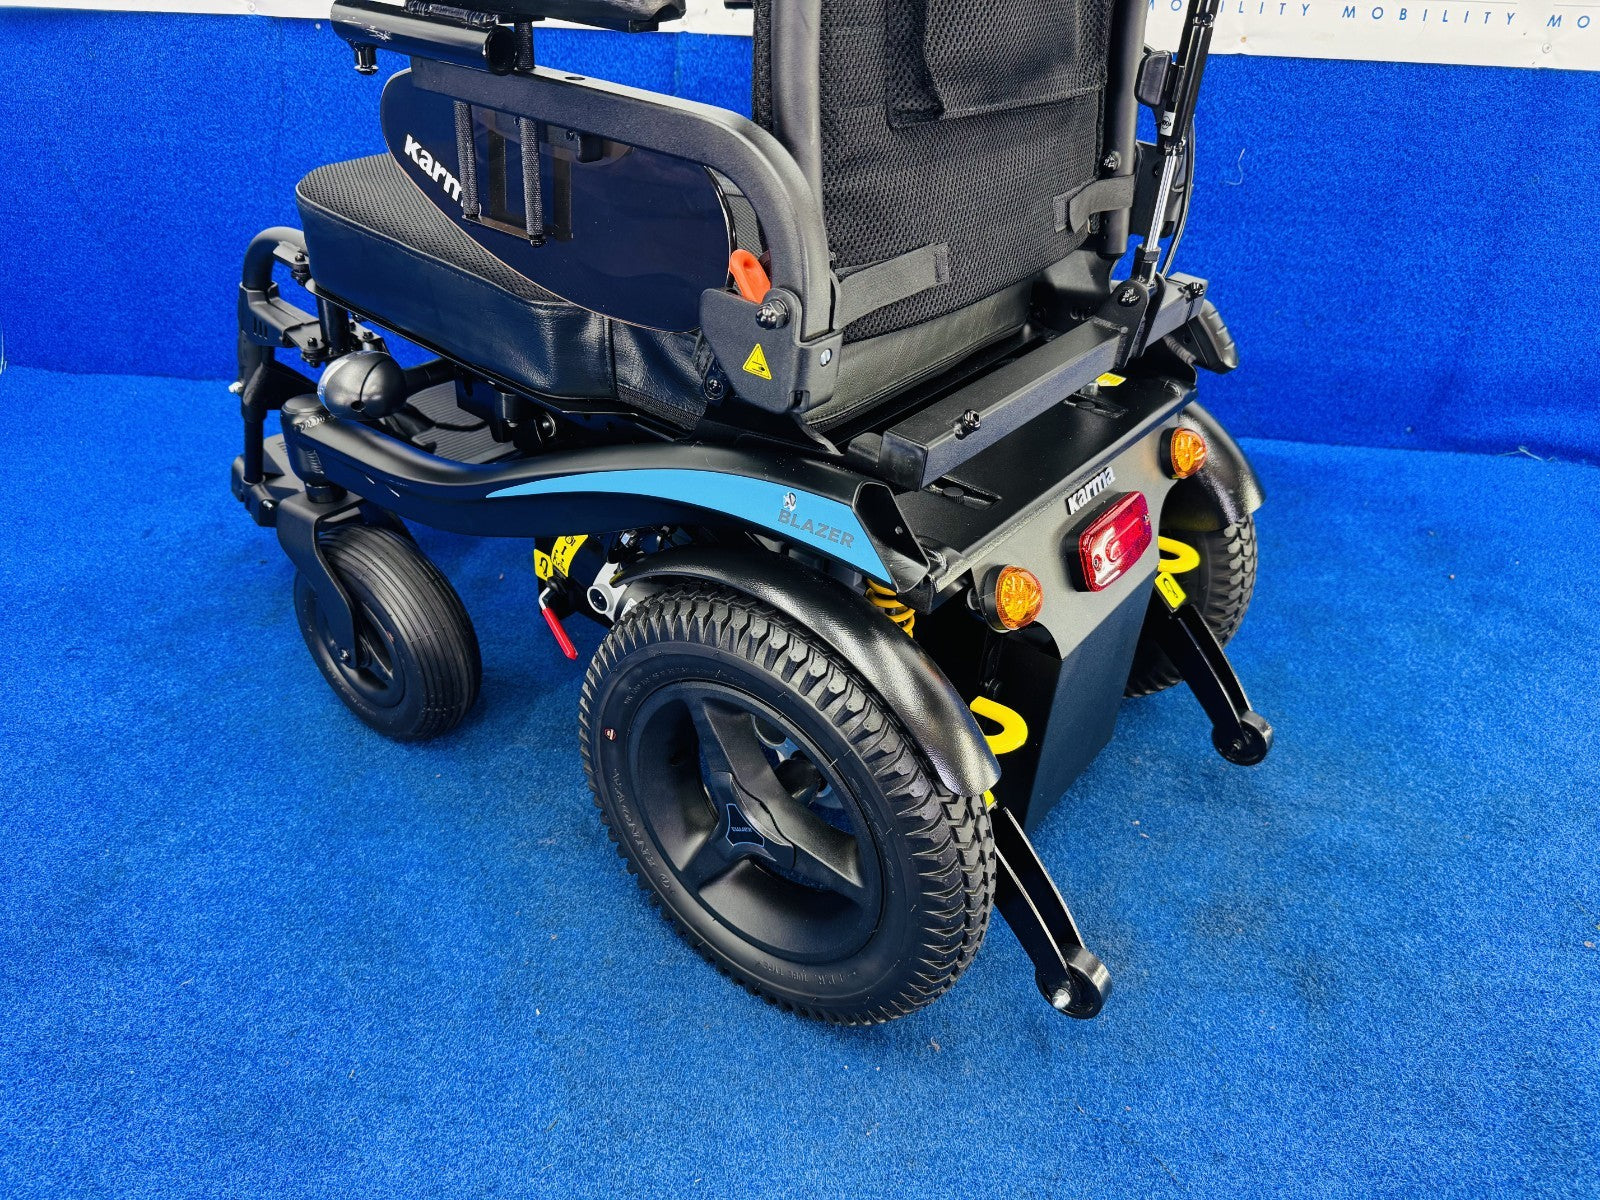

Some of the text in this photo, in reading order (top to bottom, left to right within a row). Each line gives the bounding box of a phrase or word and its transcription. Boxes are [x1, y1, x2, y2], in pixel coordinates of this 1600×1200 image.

[1341, 6, 1515, 25] MOBILITY
[404, 133, 468, 206] karm
[1066, 466, 1116, 516] karma
[777, 508, 855, 549] BLAZER
